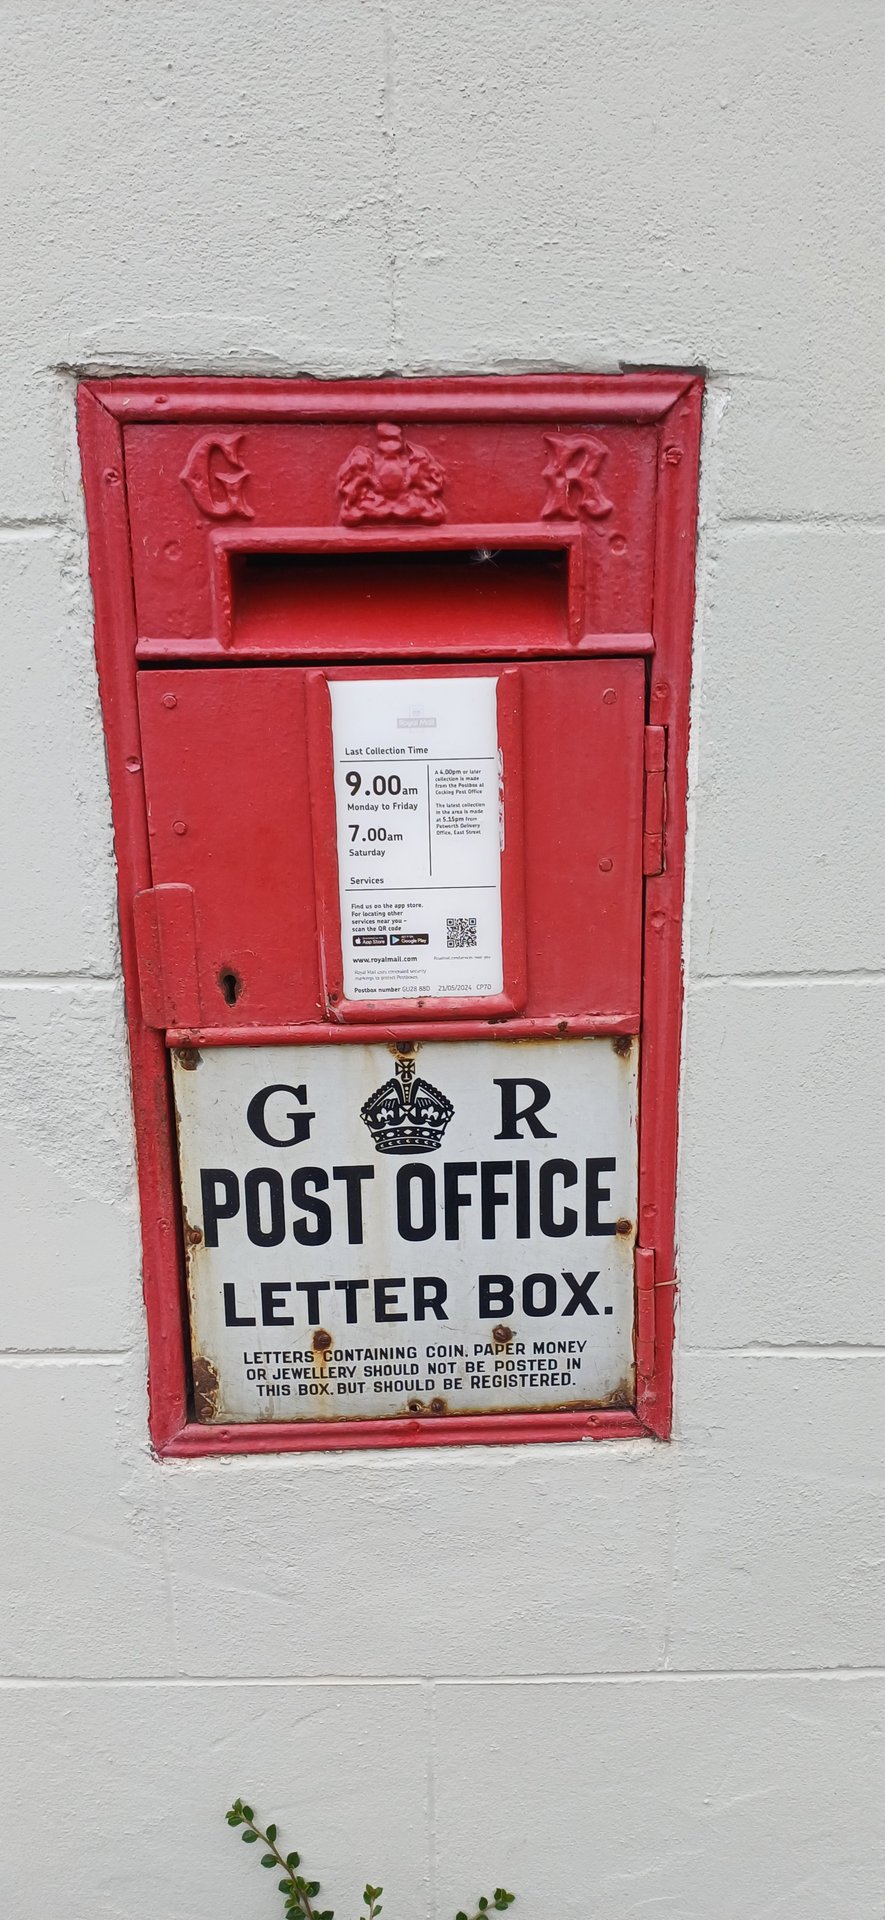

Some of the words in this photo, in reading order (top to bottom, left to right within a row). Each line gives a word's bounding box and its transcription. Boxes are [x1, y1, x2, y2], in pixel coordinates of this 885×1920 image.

[180, 433, 255, 519] G
[541, 433, 614, 519] R
[365, 747, 405, 755] Collection
[408, 746, 428, 754] Time
[345, 771, 418, 796] 9.00am
[347, 803, 378, 811] Monday
[393, 802, 418, 811] Friday
[349, 825, 403, 842] 7.00am
[349, 849, 385, 857] Saturday
[350, 877, 384, 885] Services
[247, 1084, 315, 1148] G
[493, 1078, 557, 1140] R
[200, 1165, 375, 1248] POST
[396, 1157, 617, 1241] OFFICE
[224, 1277, 448, 1327] LETTER
[478, 1271, 613, 1319] BOX.
[243, 1351, 314, 1365] LETTERS
[323, 1347, 417, 1362] CONTAINING
[474, 1343, 525, 1357] PAPER
[534, 1340, 587, 1354] MONEY
[246, 1369, 267, 1380] OR
[273, 1366, 356, 1380] JEWELLERY
[364, 1364, 419, 1377] SHOULD
[427, 1362, 457, 1374] NOT
[465, 1360, 485, 1372] BE
[494, 1359, 558, 1371] POSTED
[567, 1358, 581, 1369] IN
[257, 1384, 290, 1396] THIS
[338, 1382, 365, 1394] BUT
[374, 1379, 434, 1393] SHOULD
[444, 1377, 462, 1390] BE
[471, 1372, 575, 1388] REGISTERED.
